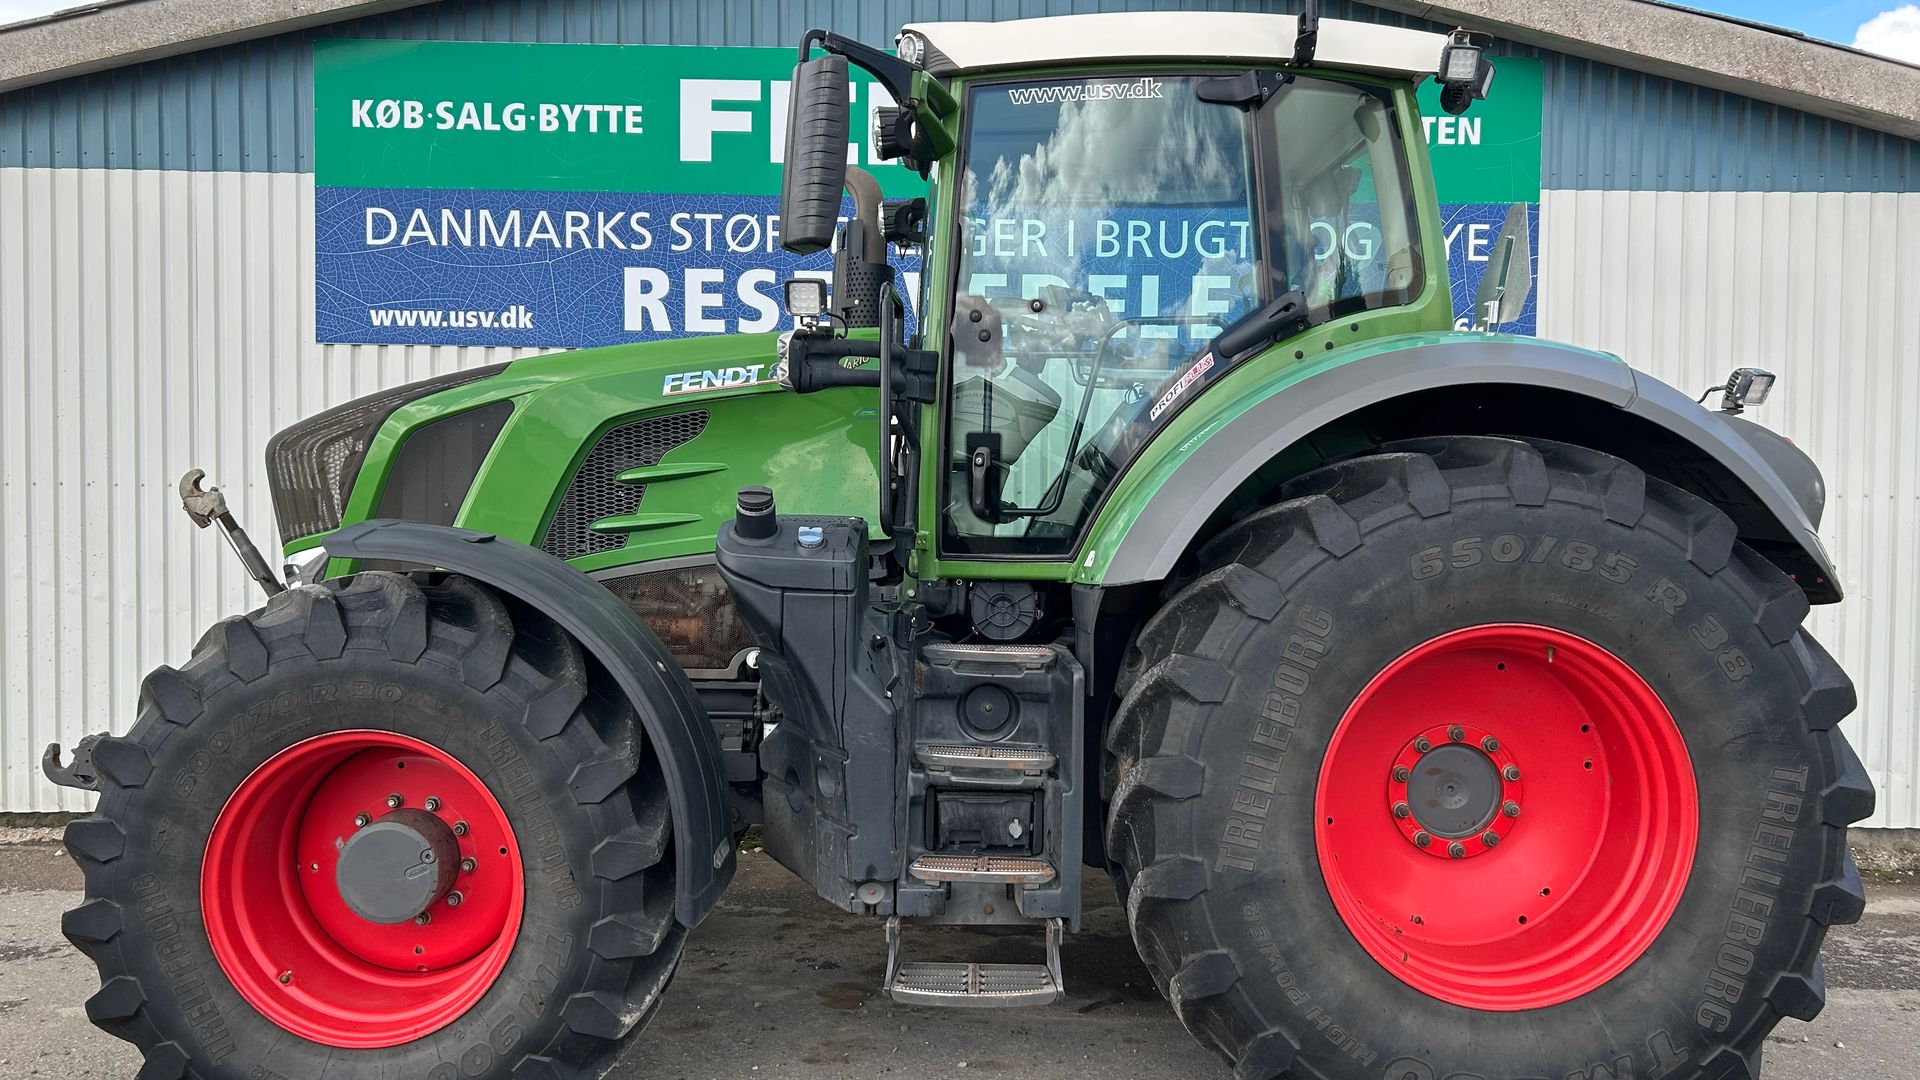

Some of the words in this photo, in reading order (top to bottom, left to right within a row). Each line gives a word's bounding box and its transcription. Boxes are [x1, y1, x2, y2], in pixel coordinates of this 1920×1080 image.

[1009, 78, 1162, 104] www.usv.dk
[1421, 116, 1481, 145] TEN
[366, 207, 652, 250] DANMARKS
[1068, 220, 1075, 257] I
[1097, 219, 1249, 259] BRUGT
[1310, 221, 1372, 261] OG
[1442, 223, 1490, 262] YE
[369, 305, 534, 329] www.usv.dk
[662, 364, 764, 396] FENDT
[1409, 533, 1639, 585] 650/85
[1214, 605, 1335, 873] TRELLEBORG
[480, 719, 583, 911] TRELLEBORG
[1696, 764, 1809, 1033] TRELLEBORG
[130, 872, 237, 1067] TRELLEBORG
